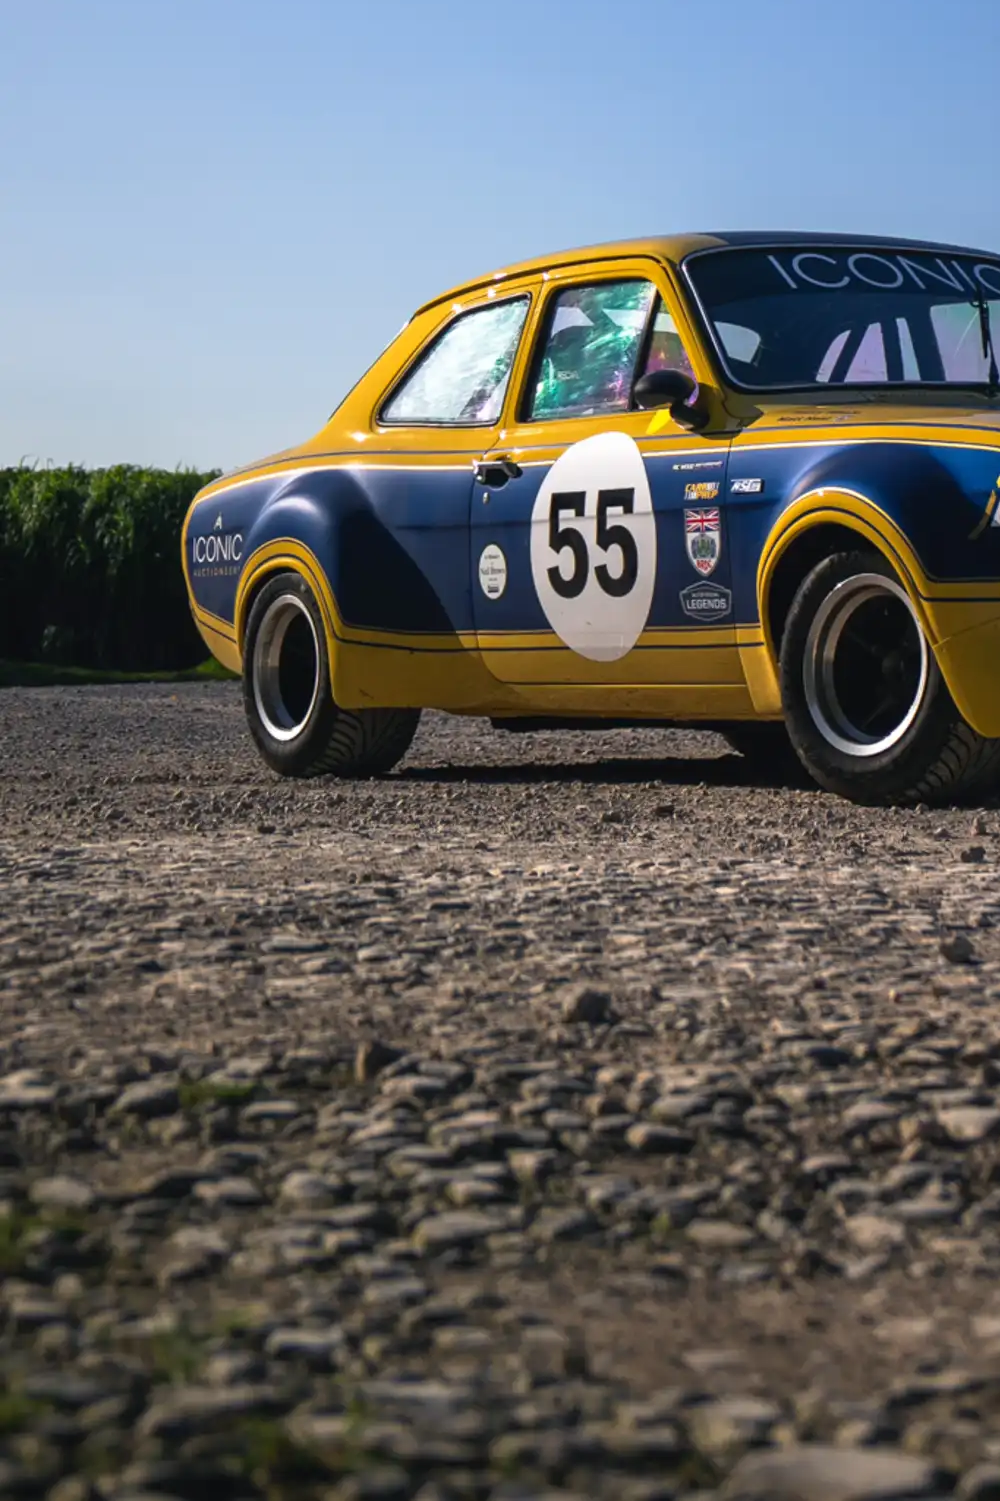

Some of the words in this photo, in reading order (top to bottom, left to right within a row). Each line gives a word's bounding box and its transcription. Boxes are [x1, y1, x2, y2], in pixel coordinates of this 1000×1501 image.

[192, 533, 243, 563] ICONIC
[546, 487, 639, 599] 55
[686, 598, 727, 610] LEGENDS
